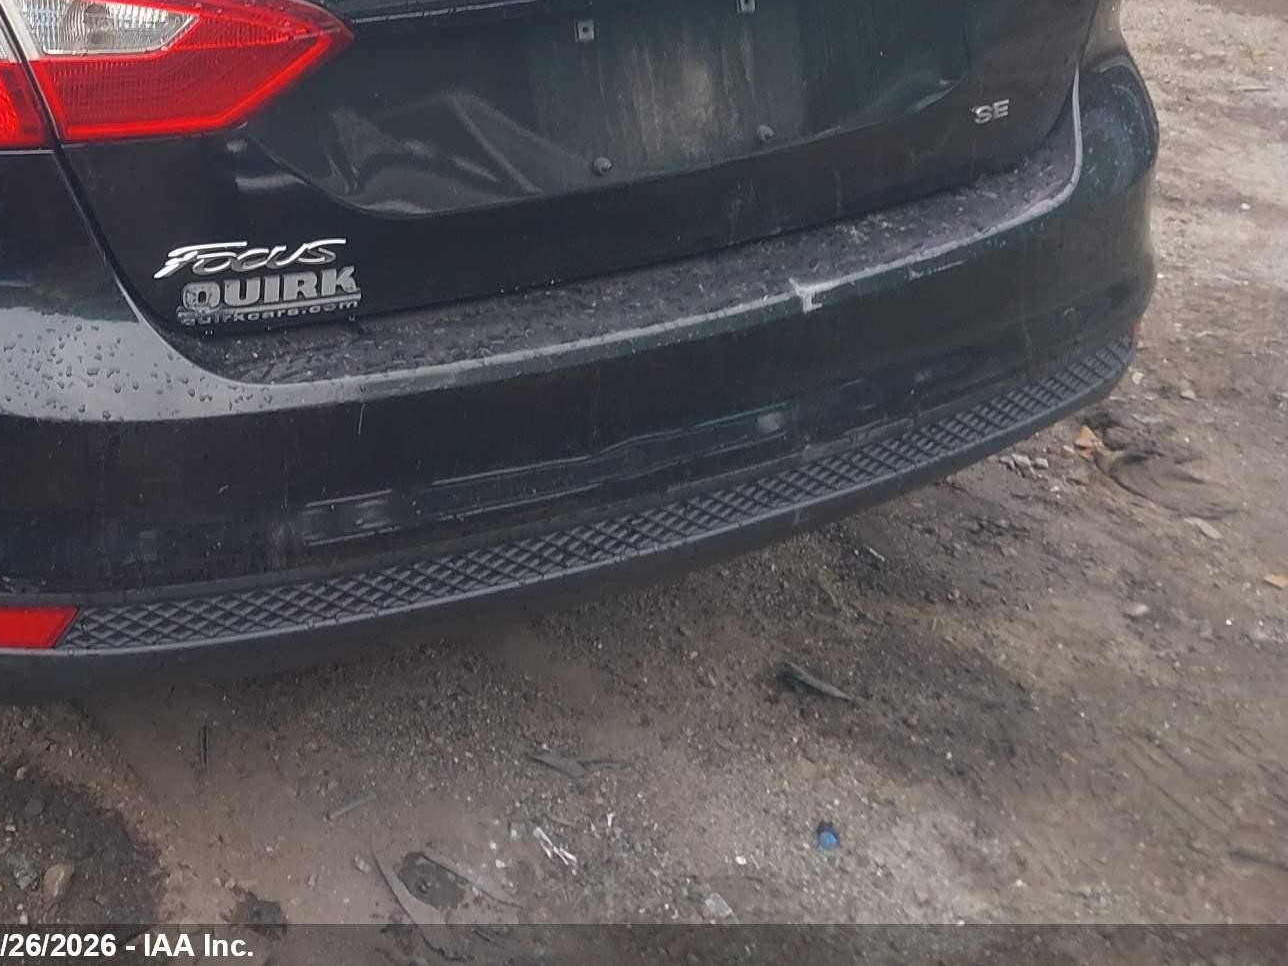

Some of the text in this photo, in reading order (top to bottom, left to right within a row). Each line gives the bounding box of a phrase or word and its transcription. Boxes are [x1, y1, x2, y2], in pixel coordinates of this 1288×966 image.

[974, 98, 1010, 124] SE
[182, 265, 361, 315] QUIRK
[177, 300, 360, 327] quirkcars.com
